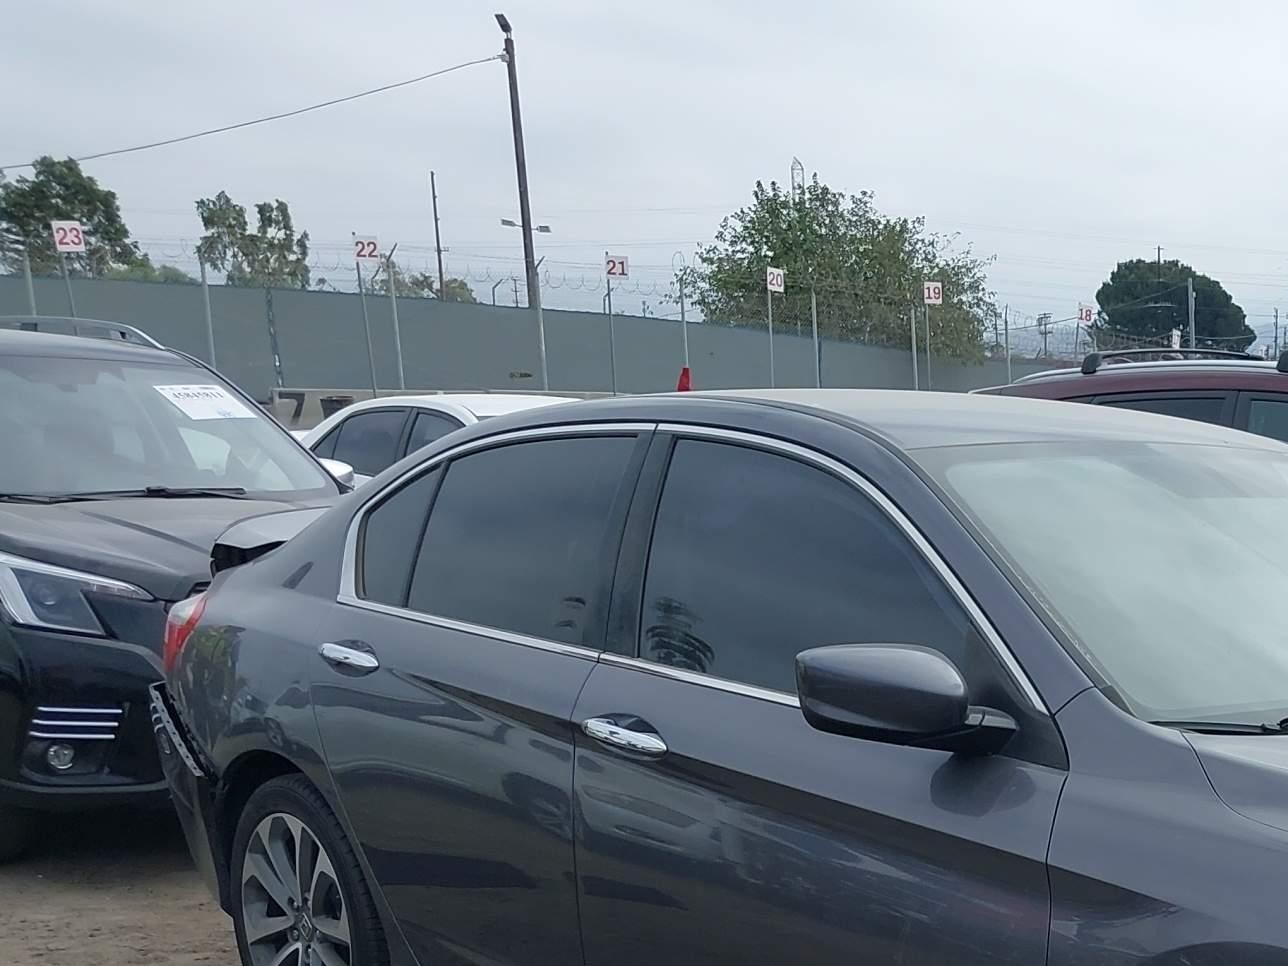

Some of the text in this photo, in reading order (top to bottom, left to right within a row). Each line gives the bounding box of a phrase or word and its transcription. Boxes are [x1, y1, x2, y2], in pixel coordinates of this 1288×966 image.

[55, 226, 82, 246] 23
[355, 240, 379, 259] 22
[606, 259, 628, 276] 21
[768, 271, 783, 288] 20
[925, 286, 941, 300] 19
[1079, 308, 1092, 322] 18
